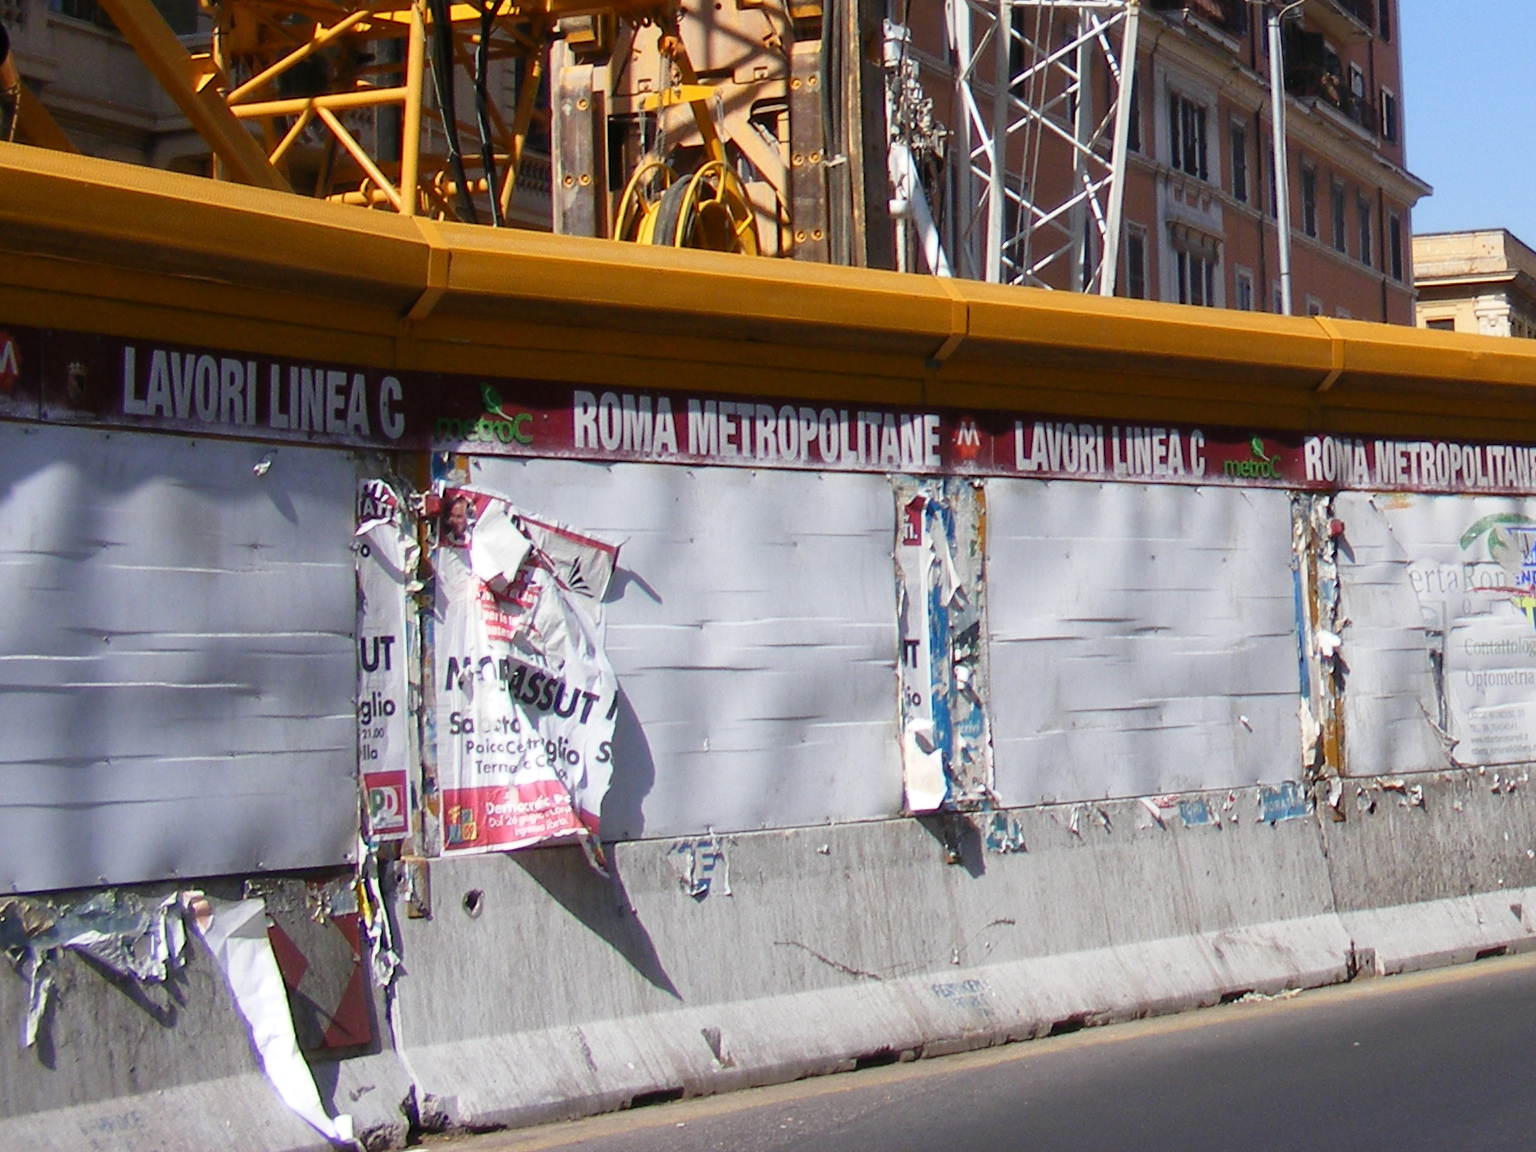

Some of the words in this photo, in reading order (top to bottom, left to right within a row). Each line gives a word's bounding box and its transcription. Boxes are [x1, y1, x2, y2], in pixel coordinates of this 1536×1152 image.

[123, 346, 257, 426] LAVORI
[269, 363, 371, 437] LINEA
[379, 375, 405, 440] C
[573, 390, 677, 455] ROMA
[687, 399, 941, 467] METROPOLITANE
[1014, 420, 1104, 475] LAVORI
[1112, 428, 1186, 478] LINEA
[1188, 430, 1206, 477] C
[1223, 454, 1281, 480] metroC
[1304, 435, 1370, 484] ROMA
[361, 636, 395, 673] UT
[1465, 669, 1535, 690] Optometria
[361, 692, 396, 725] glio
